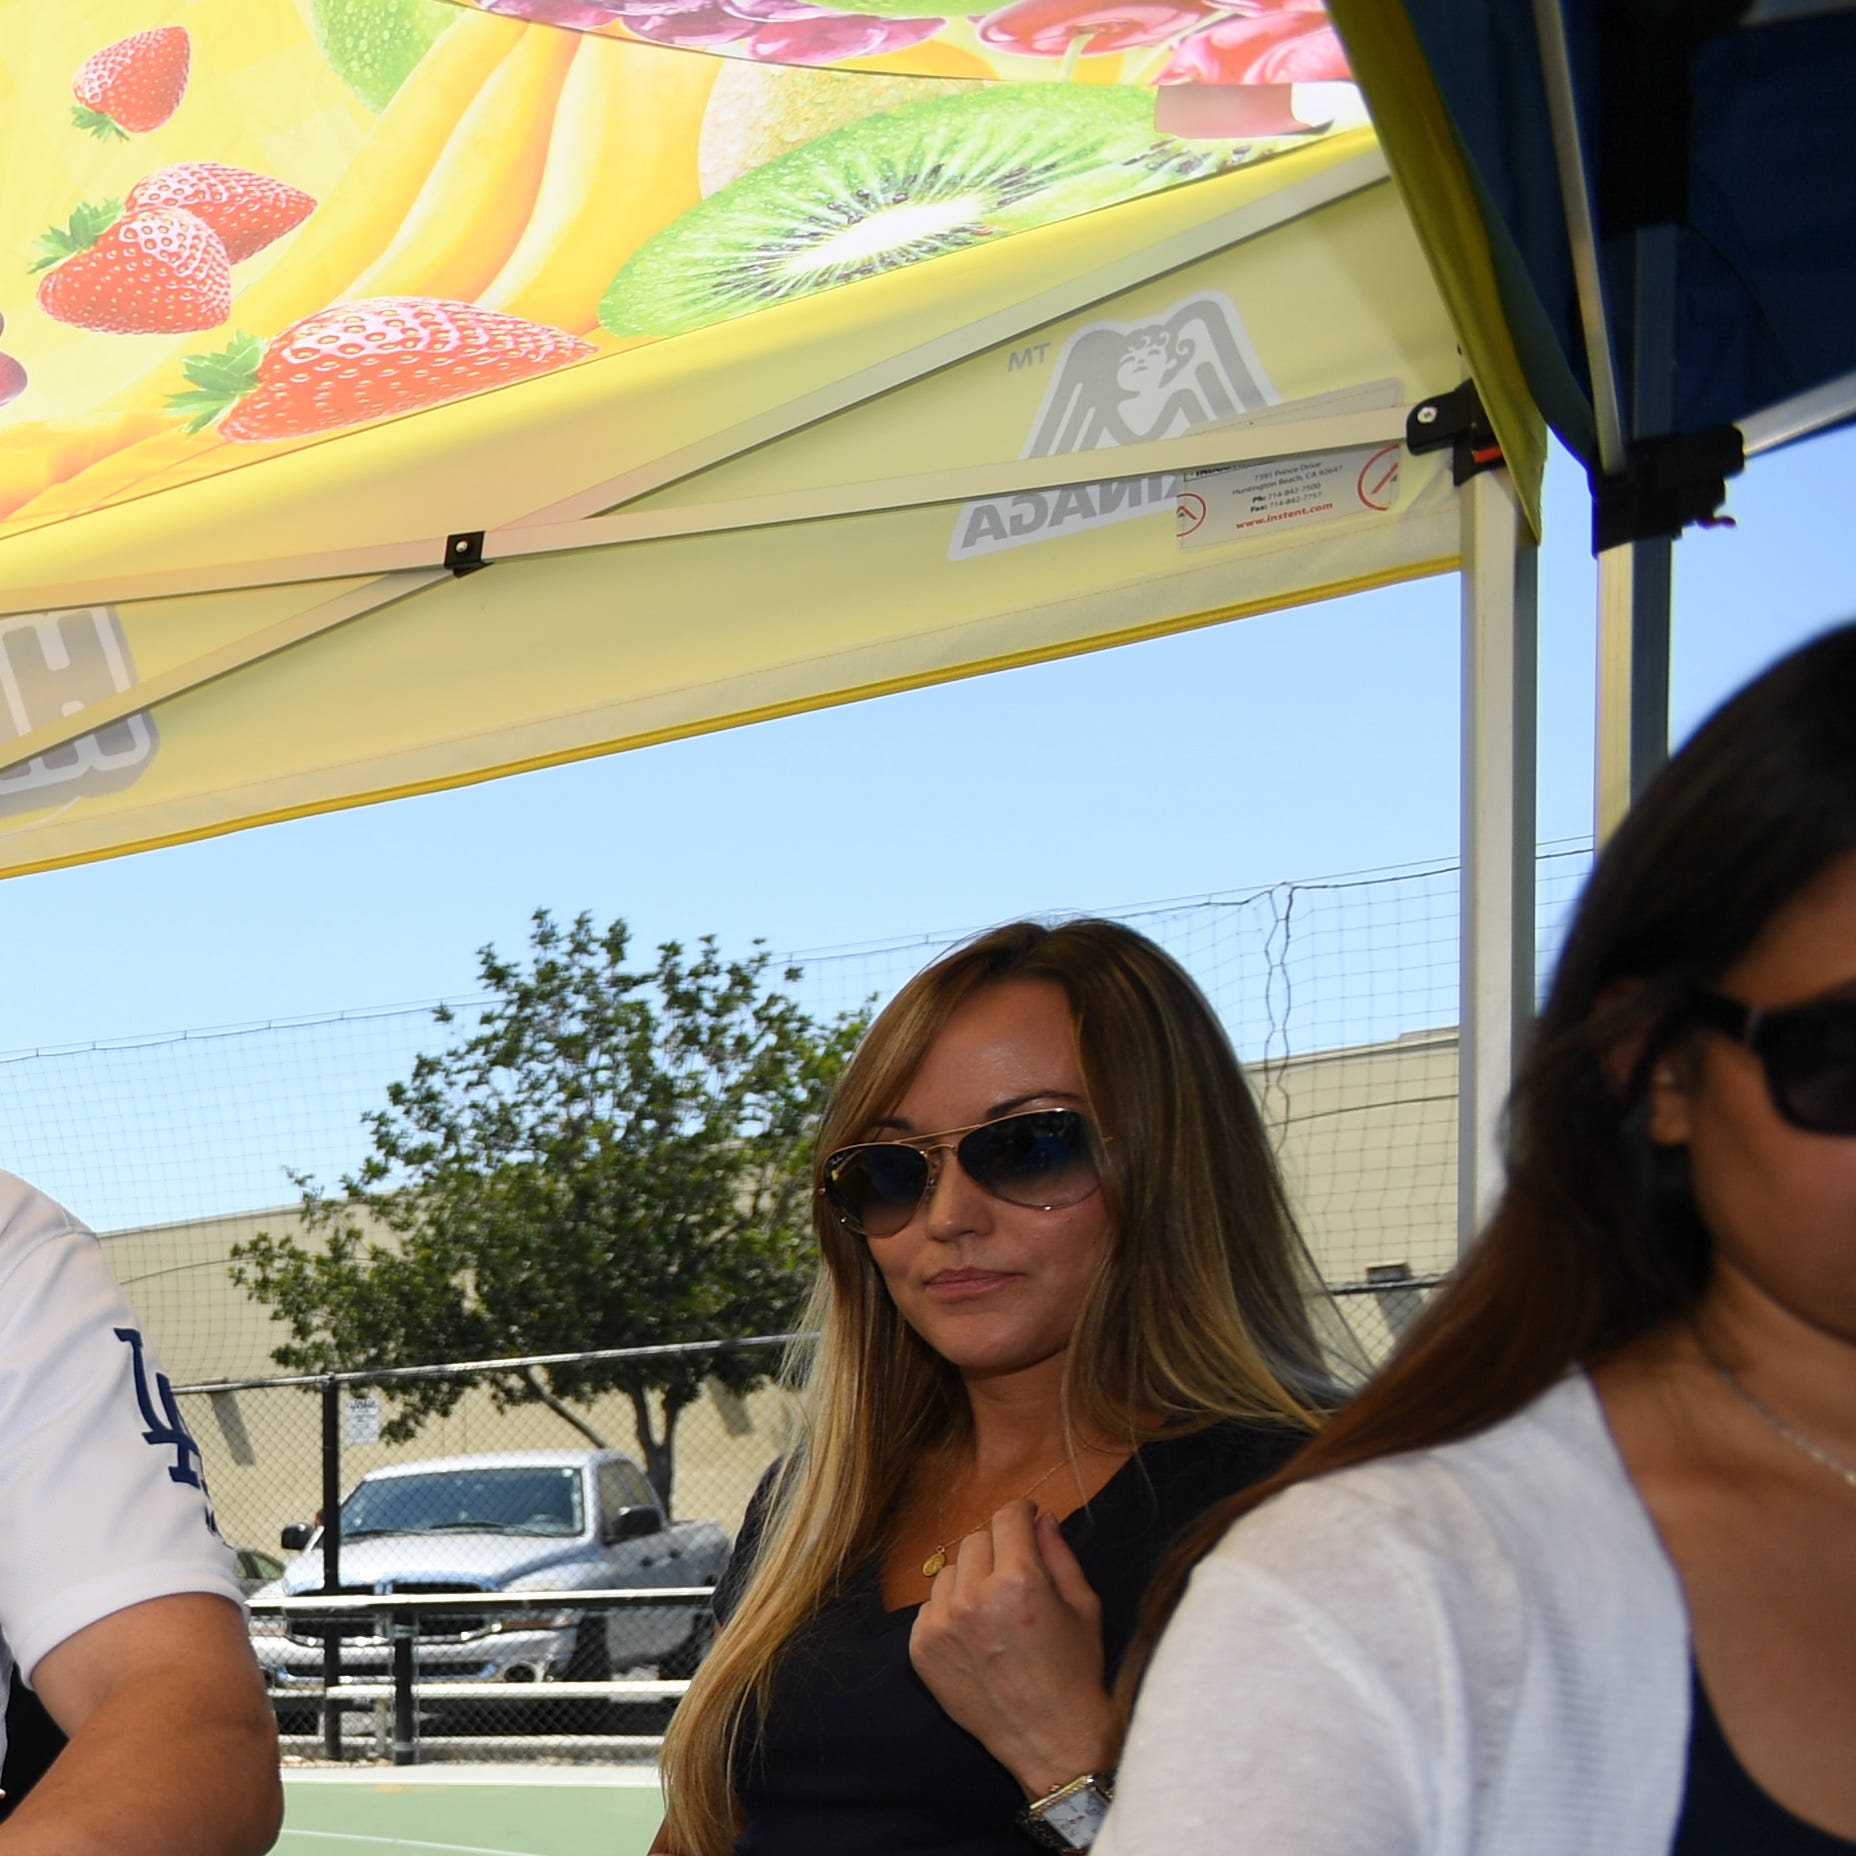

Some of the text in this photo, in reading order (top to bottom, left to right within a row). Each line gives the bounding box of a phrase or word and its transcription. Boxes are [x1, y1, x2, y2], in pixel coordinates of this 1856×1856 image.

[1300, 460, 1322, 473] Drive
[1232, 478, 1277, 496] Huntington
[1306, 471, 1317, 482] CA
[1236, 501, 1334, 530] www.instent.com
[1250, 500, 1268, 513] Fax:
